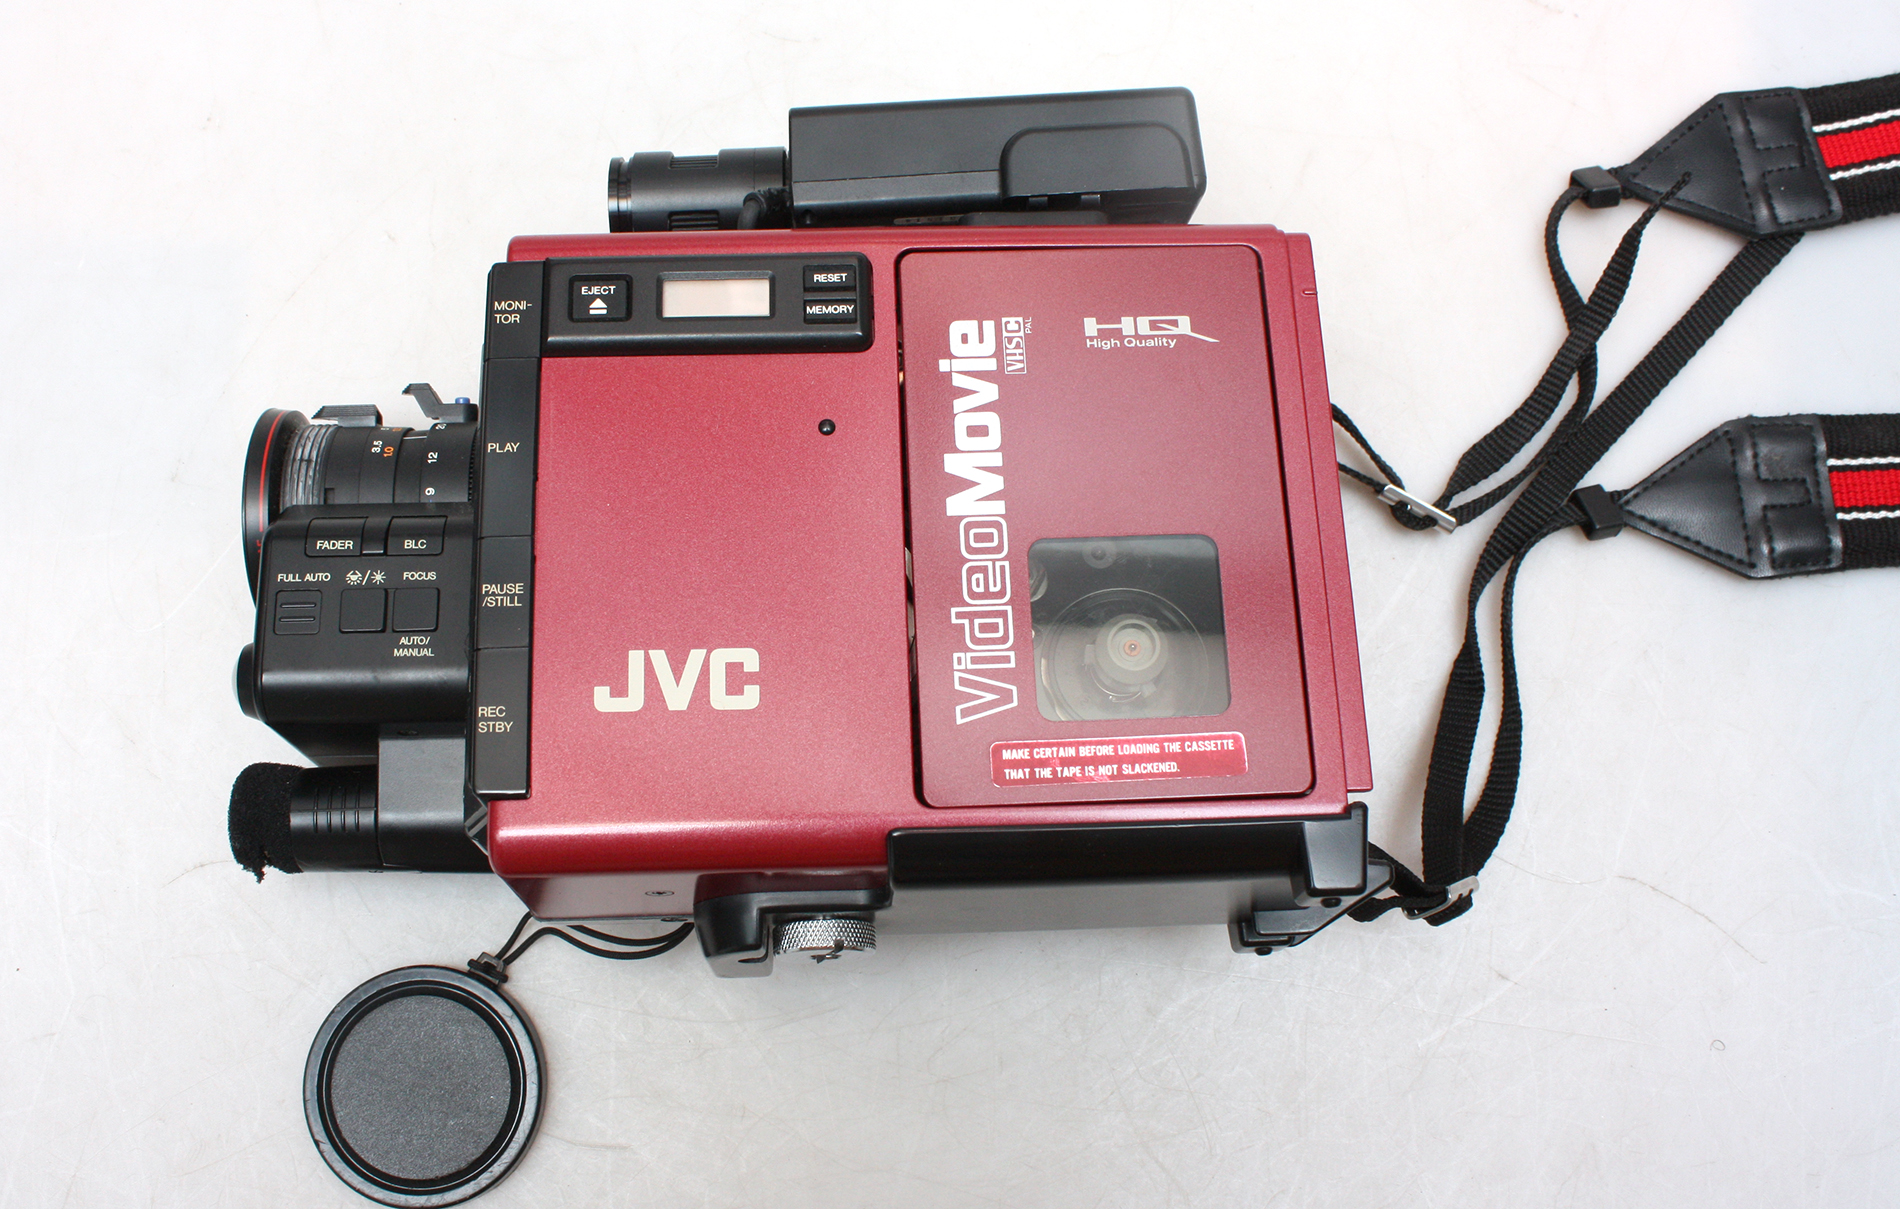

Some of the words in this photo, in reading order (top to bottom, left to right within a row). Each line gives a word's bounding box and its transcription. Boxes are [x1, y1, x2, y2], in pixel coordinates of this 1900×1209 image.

[814, 274, 847, 282] RESET
[582, 286, 615, 294] EJECT
[495, 301, 532, 310] MONI-
[807, 305, 854, 314] MEMORY
[495, 314, 520, 323] TOR
[1084, 316, 1220, 342] HQ
[1086, 338, 1121, 350] High
[1124, 337, 1177, 349] Quality
[371, 440, 383, 453] 3.5
[488, 443, 519, 452] PLAY
[427, 452, 438, 464] 12
[425, 487, 435, 496] 9
[317, 541, 353, 549] FADER
[405, 540, 426, 548] BLC
[278, 574, 301, 582] FULL
[304, 573, 330, 581] AUTO
[404, 572, 436, 580] FOCUS
[483, 583, 523, 594] PAUSE
[483, 596, 522, 607] /STILL
[400, 637, 430, 645] AUTO/
[394, 648, 434, 656] MANUAL
[594, 648, 760, 712] JVC
[479, 706, 505, 717] REC
[479, 722, 513, 732] STBY
[1003, 749, 1030, 760] MAKE
[1034, 747, 1075, 758] CERTAIN
[1079, 745, 1114, 756] BEFORE
[1118, 743, 1160, 755] LOADING
[1163, 742, 1181, 752] THE
[1185, 740, 1234, 751] CASSETTE
[1004, 769, 1030, 779] THAT
[1034, 768, 1053, 778] THE
[1056, 766, 1082, 777] TAPE
[1085, 766, 1095, 776] IS
[1098, 765, 1118, 775] NOT
[1122, 762, 1180, 774] SLACKENED.
